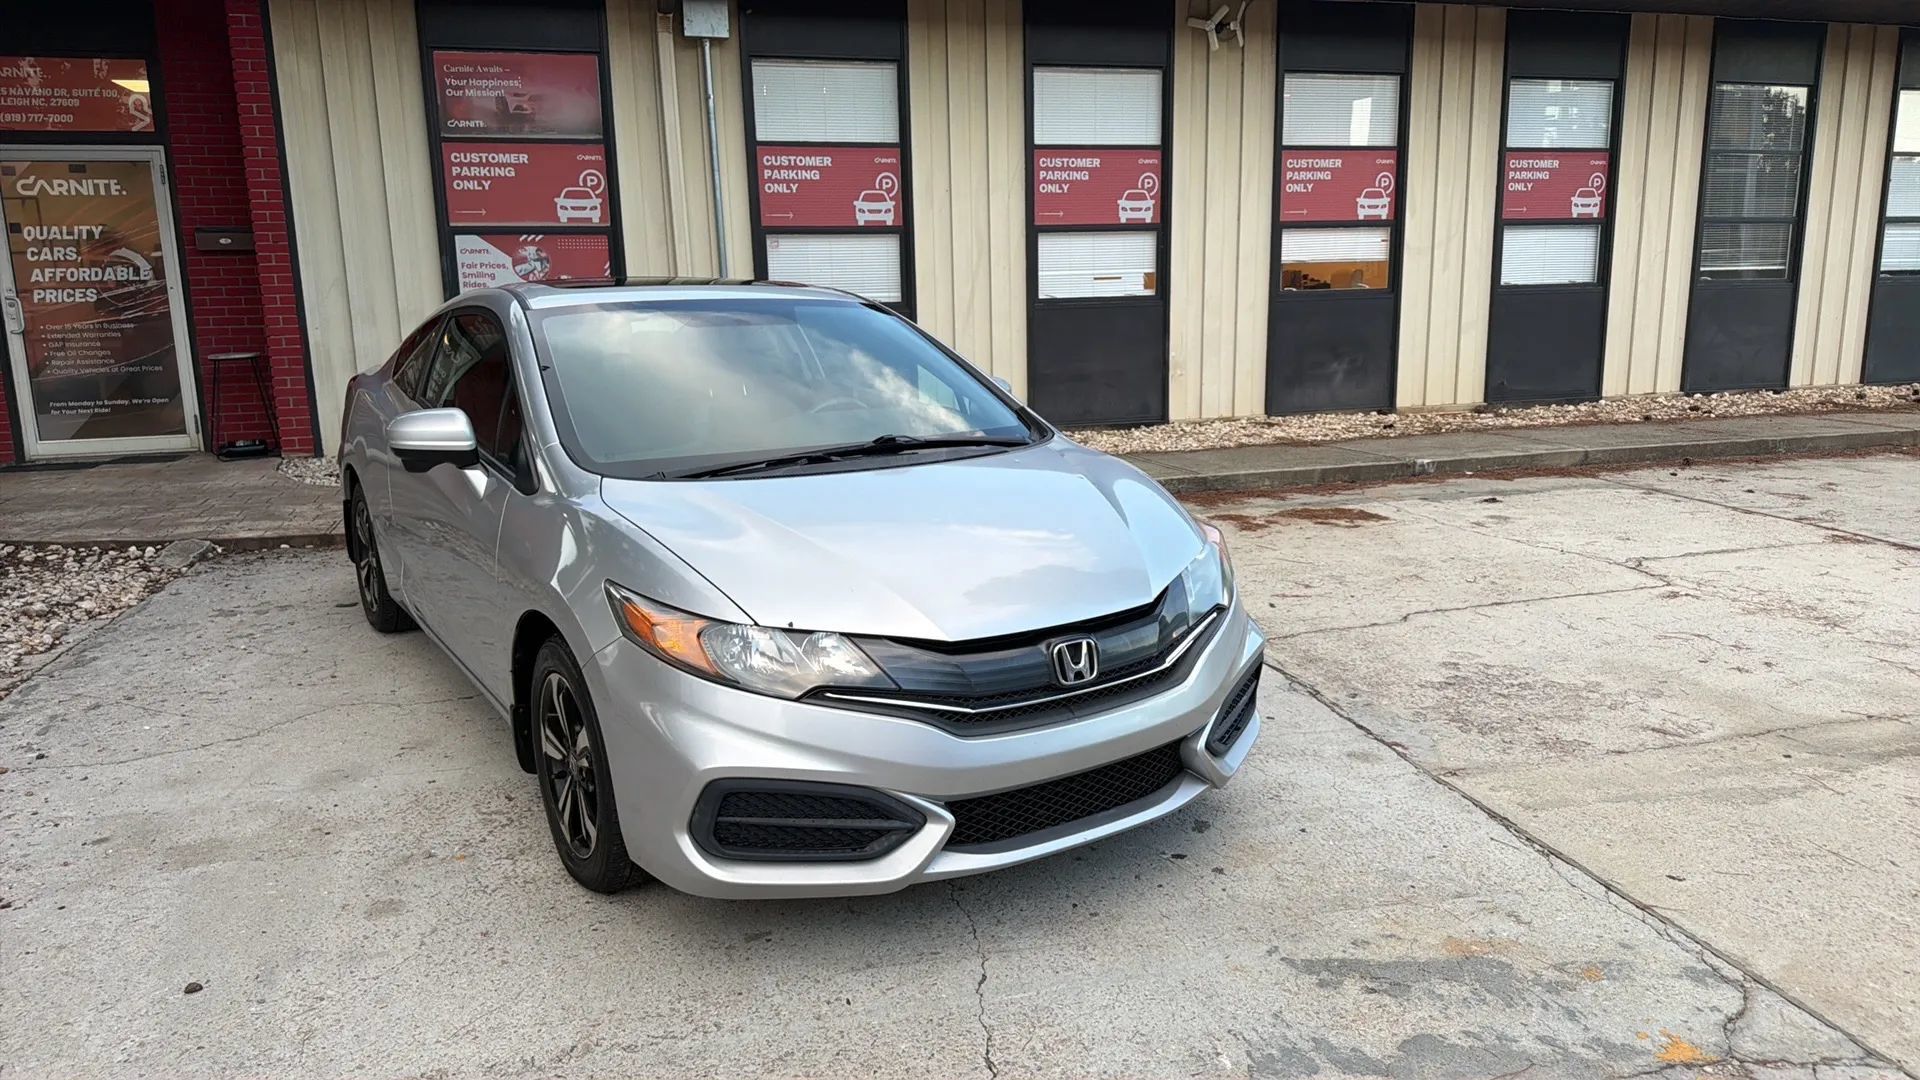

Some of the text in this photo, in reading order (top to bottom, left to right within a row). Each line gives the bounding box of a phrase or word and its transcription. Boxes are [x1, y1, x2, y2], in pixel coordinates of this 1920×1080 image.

[443, 64, 475, 73] Carnite
[445, 77, 468, 87] Your
[54, 88, 70, 99] DR,
[445, 88, 505, 97] Our Mission!
[0, 97, 30, 106] LEIGH
[28, 113, 74, 123] 717-7000
[450, 152, 529, 164] CUSTOMER
[763, 155, 832, 167] CUSTOMER
[1039, 157, 1101, 168] CUSTOMER
[1286, 159, 1342, 168] CUSTOMER
[1509, 159, 1560, 168] CUSTOMER
[451, 166, 516, 178] PARKING
[764, 169, 820, 180] PARKING
[1039, 170, 1089, 181] PARKING
[1286, 171, 1332, 180] PARKING
[1508, 171, 1550, 180] PARKING
[452, 180, 492, 191] ONLY
[764, 183, 799, 193] ONLY
[1039, 183, 1070, 193] ONLY
[1285, 183, 1314, 193] ONLY
[1508, 182, 1533, 191] ONLY
[23, 225, 104, 242] QUALITY
[26, 247, 82, 263] CARS,
[461, 262, 509, 270] Fair Prices,
[30, 267, 152, 282] AFFORDABLE
[462, 271, 496, 280] Smiling
[33, 288, 98, 303] PRICES
[68, 400, 95, 409] Monday
